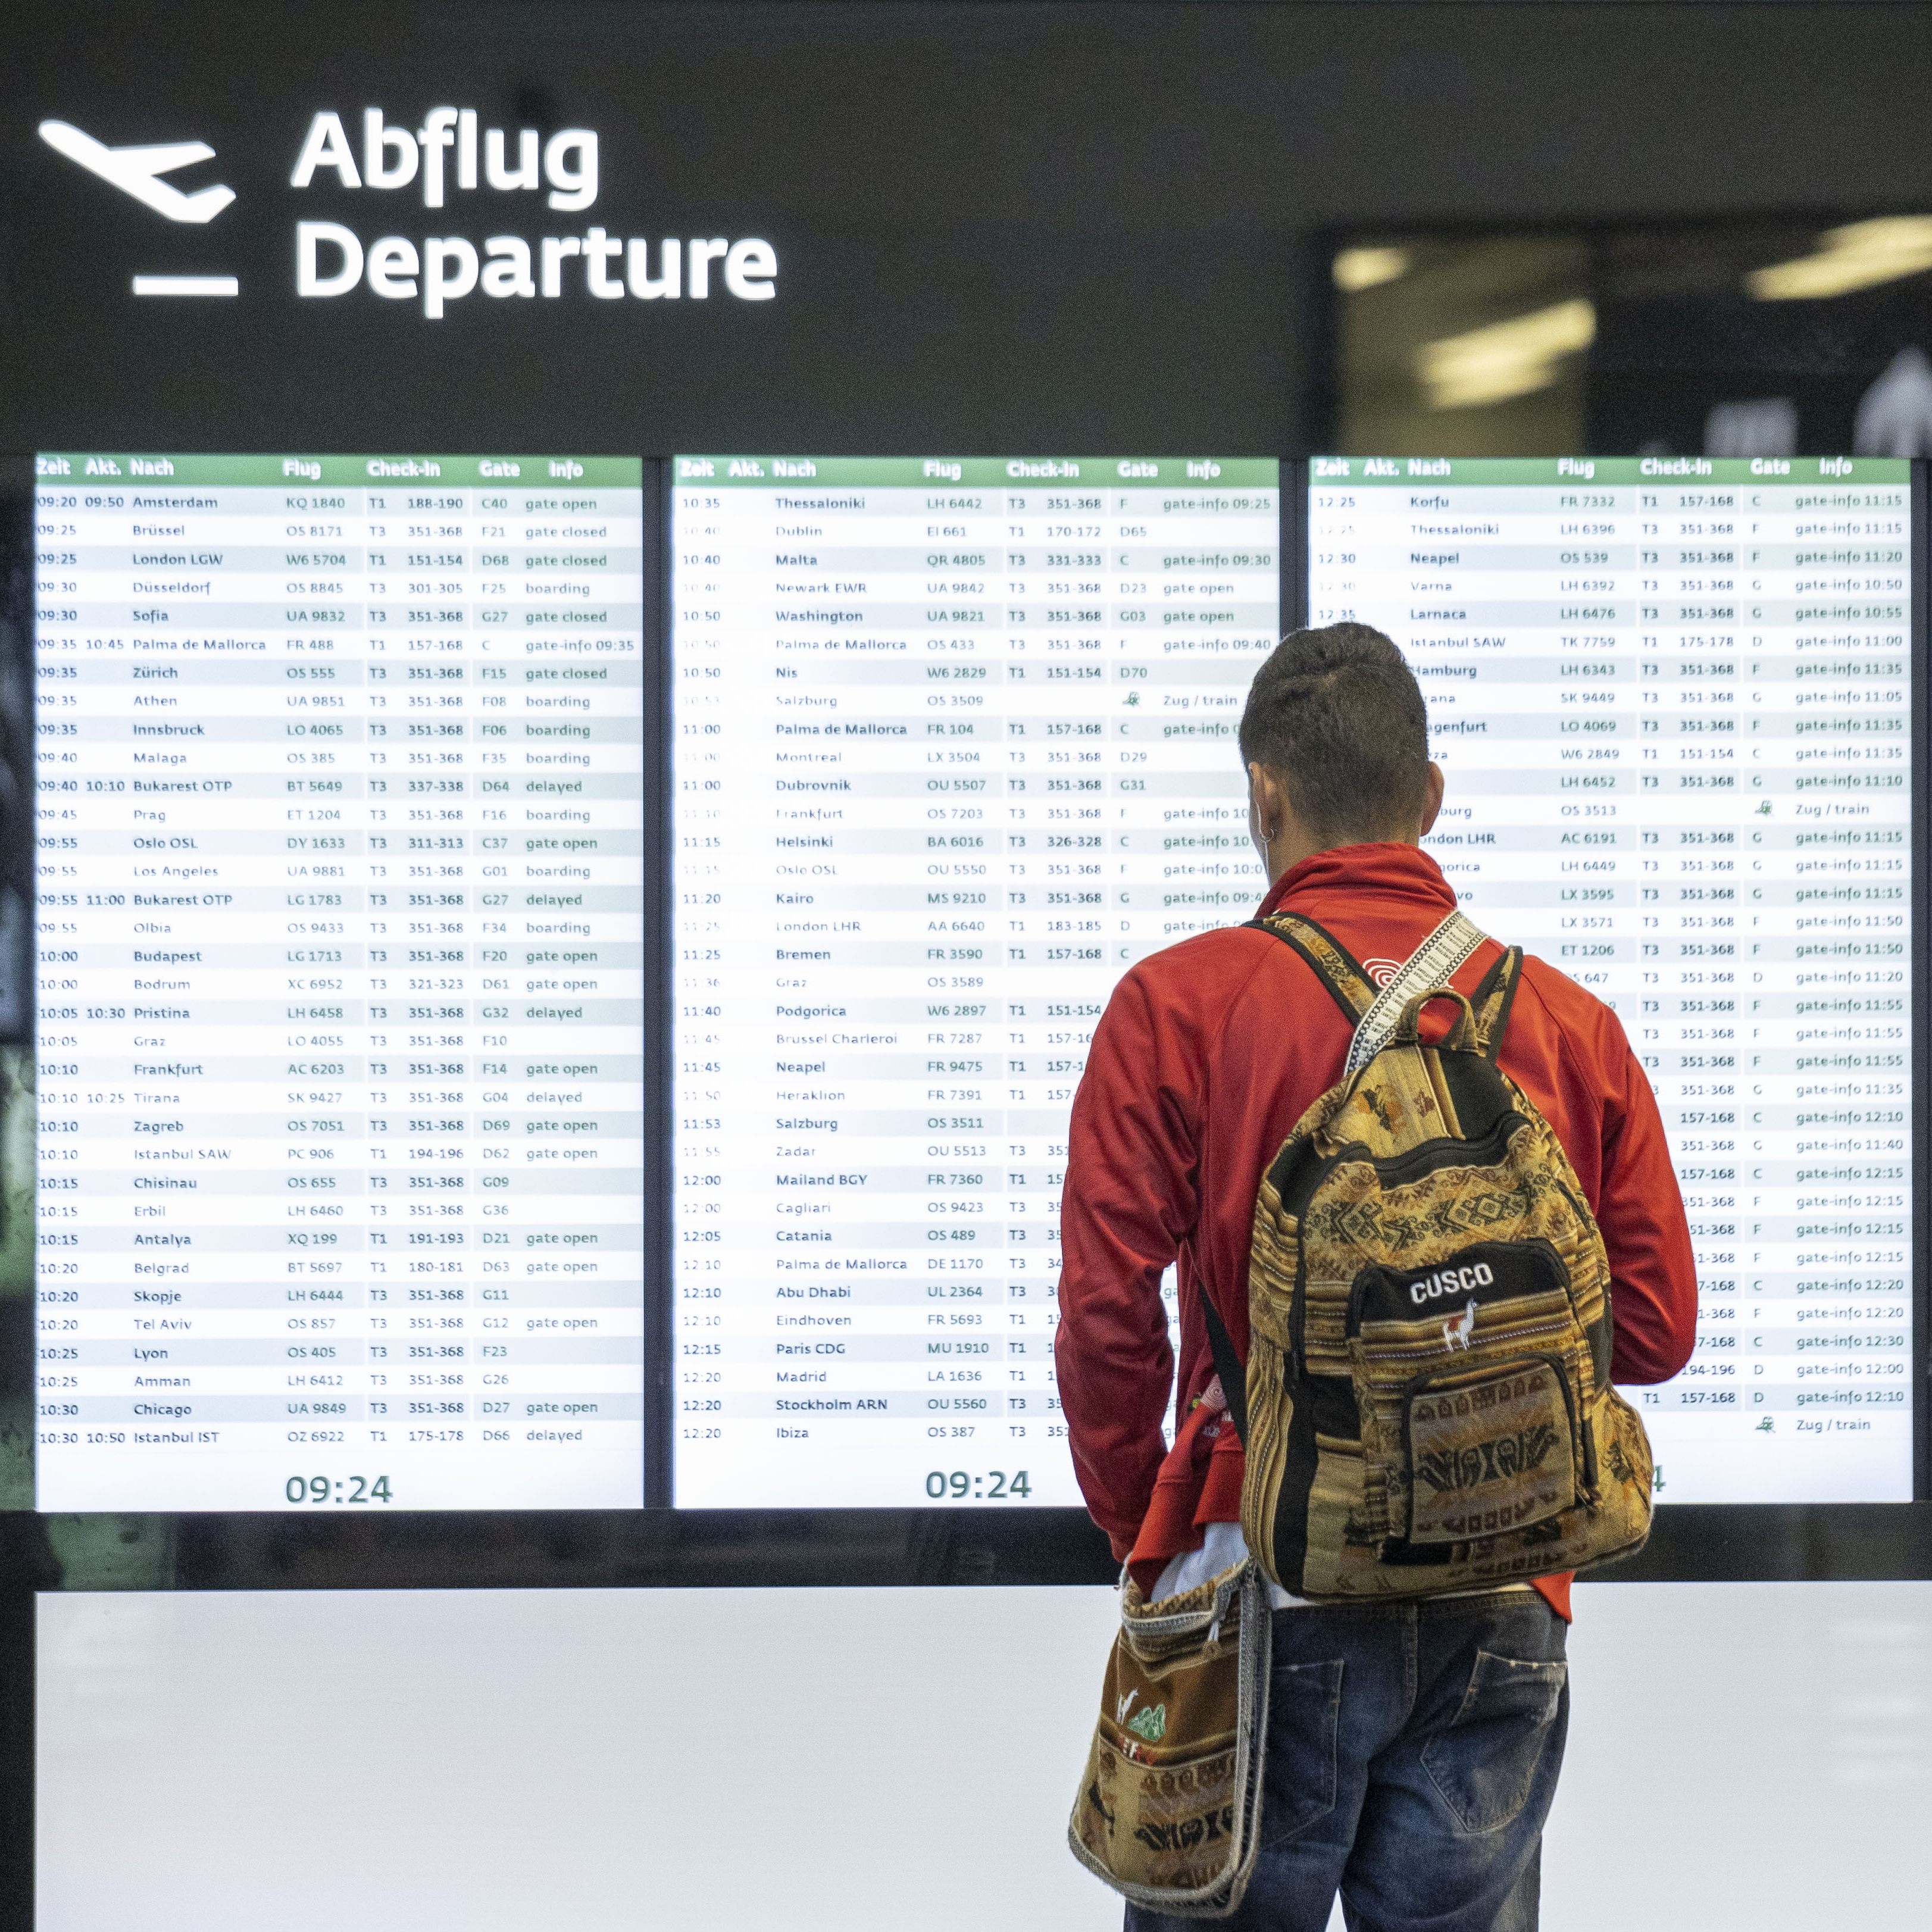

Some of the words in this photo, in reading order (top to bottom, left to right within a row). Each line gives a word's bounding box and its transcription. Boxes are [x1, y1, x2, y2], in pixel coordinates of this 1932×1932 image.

[291, 107, 598, 211] Abflug
[298, 222, 777, 318] Departure
[37, 458, 70, 474] Zeit
[86, 458, 120, 474] Akt.
[131, 459, 173, 474] Nach
[283, 459, 320, 479] Flug
[480, 460, 520, 476] Gate
[550, 460, 583, 479] Info
[680, 459, 714, 477] Zeit
[729, 459, 764, 476] Akt.
[773, 459, 816, 476] Nach
[924, 459, 961, 480] Flug
[1118, 460, 1158, 477] Gate
[1187, 460, 1220, 479] Info
[1315, 458, 1349, 476] Zeit
[1364, 458, 1399, 475] Akt.
[1408, 459, 1450, 475] Nach
[1558, 459, 1594, 478] Flug
[1751, 458, 1790, 474] Gate
[1820, 458, 1852, 476] Info
[37, 496, 77, 508] 09:20
[85, 496, 124, 508] 09:50
[133, 496, 218, 508] Amsterdam
[286, 497, 308, 511] KQ
[312, 497, 345, 509] 1840
[368, 497, 386, 509] T1
[408, 498, 463, 509] 188-190
[481, 498, 508, 509] C40
[525, 499, 558, 512] gate
[561, 500, 598, 512] open
[775, 497, 865, 509] Thessaloniki
[927, 498, 945, 509] LH
[948, 498, 982, 509] 6442
[1008, 497, 1026, 509] T3
[1048, 498, 1102, 509] 351-368
[1119, 498, 1127, 509] F
[1163, 497, 1229, 513] gate-info
[1232, 498, 1271, 509] 09:25
[776, 554, 818, 566] Malta
[926, 554, 949, 568] QR
[952, 554, 986, 566] 4805
[1008, 554, 1026, 566] T3
[1047, 554, 1102, 566] 331-333
[1119, 554, 1129, 566] C
[1163, 554, 1229, 569] gate-info
[1232, 554, 1271, 566] 09:30
[1410, 552, 1459, 567] Neapel
[1559, 552, 1580, 564] OS
[1583, 551, 1609, 564] 539
[1642, 551, 1659, 564] T3
[1680, 552, 1734, 563] 351-368
[1752, 551, 1760, 562] F
[1795, 550, 1861, 566] gate-info
[1865, 551, 1903, 562] 11:20
[776, 609, 863, 625] Washington
[927, 610, 948, 622] UA
[951, 610, 984, 622] 9821
[1008, 610, 1026, 622] T3
[1048, 611, 1102, 622] 351-368
[1120, 610, 1146, 622] G03
[1163, 611, 1196, 625] gate
[1199, 612, 1234, 625] open
[37, 780, 78, 792] 09:40
[86, 780, 126, 792] 10:10
[133, 780, 198, 792] Bukarest
[202, 780, 233, 792] OTP
[286, 780, 305, 792] BT
[309, 780, 343, 792] 5649
[369, 780, 387, 792] T3
[408, 780, 464, 792] 337-338
[482, 780, 510, 792] D64
[526, 780, 583, 795] delayed
[40, 951, 79, 962] 10:00
[133, 950, 202, 965] Budapest
[287, 951, 305, 962] LG
[308, 950, 342, 962] 1713
[369, 950, 387, 962] T3
[409, 950, 464, 962] 351-368
[482, 950, 508, 962] F20
[526, 951, 559, 965] gate
[562, 952, 598, 965] open
[683, 949, 721, 961] 11:25
[776, 949, 831, 960] Bremen
[927, 948, 946, 960] FR
[950, 948, 983, 960] 3590
[1009, 948, 1026, 960] T1
[1048, 948, 1102, 960] 157-168
[1120, 948, 1130, 960] C
[1561, 945, 1578, 956] ET
[1581, 945, 1615, 956] 1206
[1642, 944, 1659, 956] T3
[1680, 944, 1735, 956] 351-368
[1752, 943, 1761, 955] F
[1796, 942, 1862, 958] gate-info
[1865, 943, 1903, 955] 11:50
[1680, 1168, 1735, 1180] 157-168
[1752, 1168, 1762, 1180] C
[1796, 1167, 1862, 1183] gate-info
[1865, 1167, 1903, 1179] 12:15
[40, 1234, 79, 1246] 10:15
[134, 1233, 192, 1248] Antalya
[287, 1233, 309, 1247] XQ
[312, 1233, 337, 1245] 199
[370, 1233, 387, 1245] T1
[409, 1233, 464, 1245] 191-193
[482, 1232, 510, 1244] D21
[526, 1233, 559, 1247] gate
[562, 1234, 598, 1247] open
[1410, 1262, 1493, 1303] CUSCO
[683, 1287, 722, 1299] 12:10
[776, 1287, 804, 1298] Abu
[808, 1286, 851, 1298] Dhabi
[927, 1286, 946, 1298] UL
[949, 1286, 983, 1298] 2364
[1008, 1286, 1027, 1298] T3
[683, 1399, 722, 1411] 12:20
[776, 1399, 852, 1411] Stockholm
[856, 1399, 887, 1410] ARN
[927, 1398, 950, 1410] OU
[954, 1398, 987, 1410] 5560
[1008, 1398, 1027, 1409] T3
[1643, 1392, 1661, 1404] T1
[1681, 1392, 1736, 1404] 157-168
[1753, 1392, 1765, 1403] D
[1796, 1390, 1862, 1406] gate-info
[1866, 1391, 1905, 1403] 12:10
[40, 1404, 79, 1416] 10:30
[133, 1403, 192, 1418] Chicago
[287, 1403, 310, 1414] UA
[312, 1402, 346, 1414] 9849
[370, 1402, 387, 1414] T3
[409, 1402, 464, 1414] 351-368
[482, 1401, 511, 1414] D27
[526, 1402, 559, 1417] gate
[562, 1403, 598, 1416] open
[1796, 1419, 1823, 1434] Zug
[1827, 1419, 1833, 1431] /
[1836, 1418, 1871, 1431] train
[286, 1475, 393, 1504] 09:24
[926, 1470, 1031, 1499] 09:24
